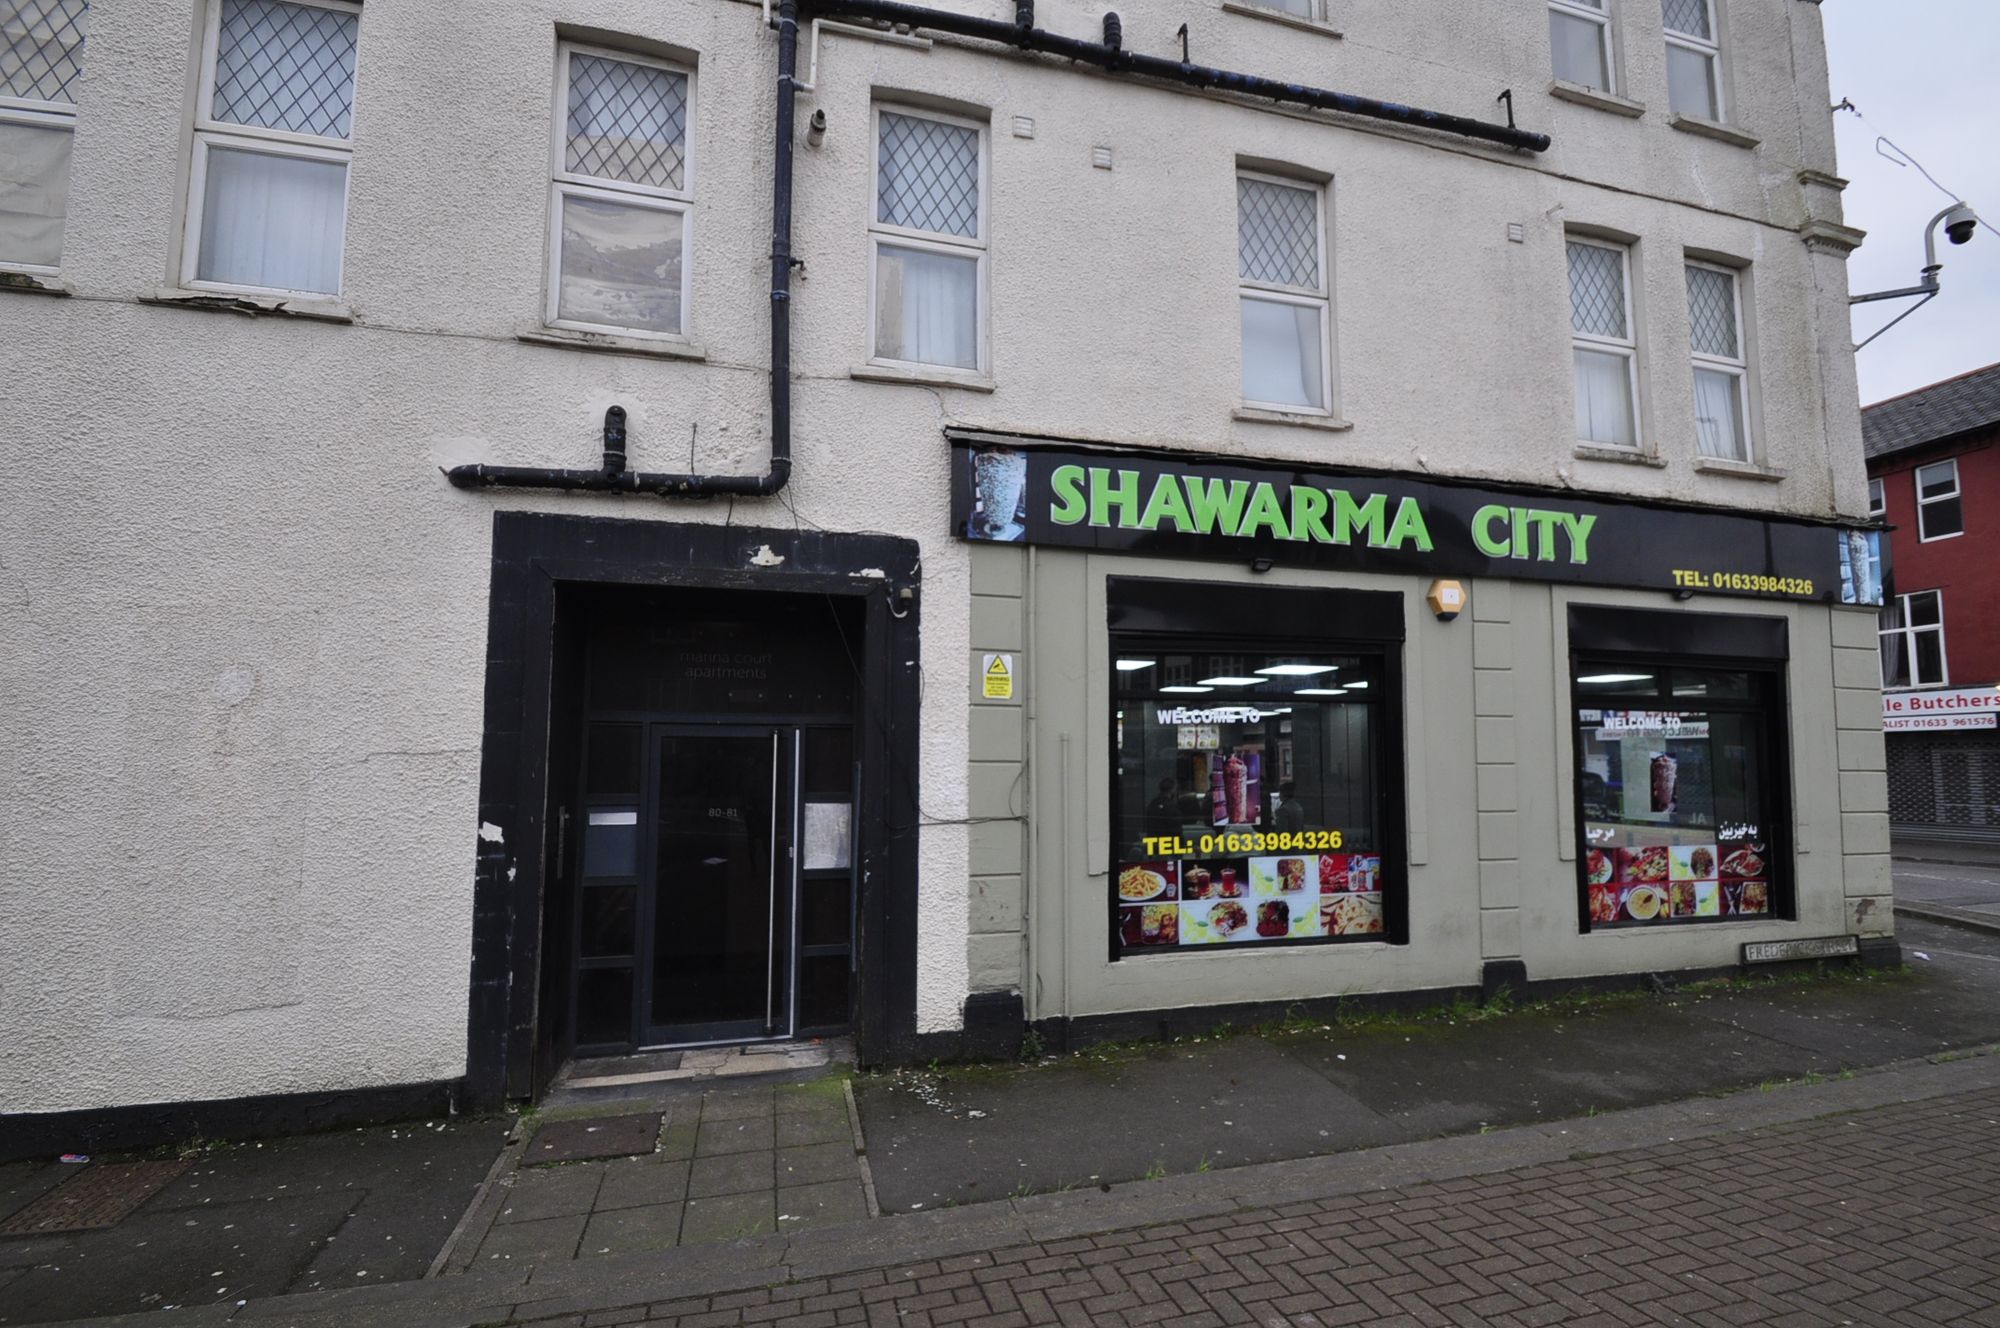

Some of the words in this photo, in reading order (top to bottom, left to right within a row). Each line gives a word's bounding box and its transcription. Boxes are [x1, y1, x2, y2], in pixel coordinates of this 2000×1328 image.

[1050, 464, 1434, 552] SHAWARMA
[1471, 504, 1597, 564] CITY
[1672, 569, 1709, 588] TEL:
[1712, 571, 1814, 596] 01633984326
[686, 665, 767, 680] apartments
[1157, 709, 1236, 724] WELCOME
[1241, 708, 1261, 724] TO
[1603, 716, 1662, 730] WELCOME
[1662, 717, 1681, 730] TO
[1913, 719, 1948, 728] 01633
[1952, 717, 1995, 726] 961576
[708, 807, 738, 817] 80-81
[1585, 826, 1615, 844] مرحبا
[1143, 836, 1194, 856] TEL:
[1200, 831, 1342, 854] 01633984326
